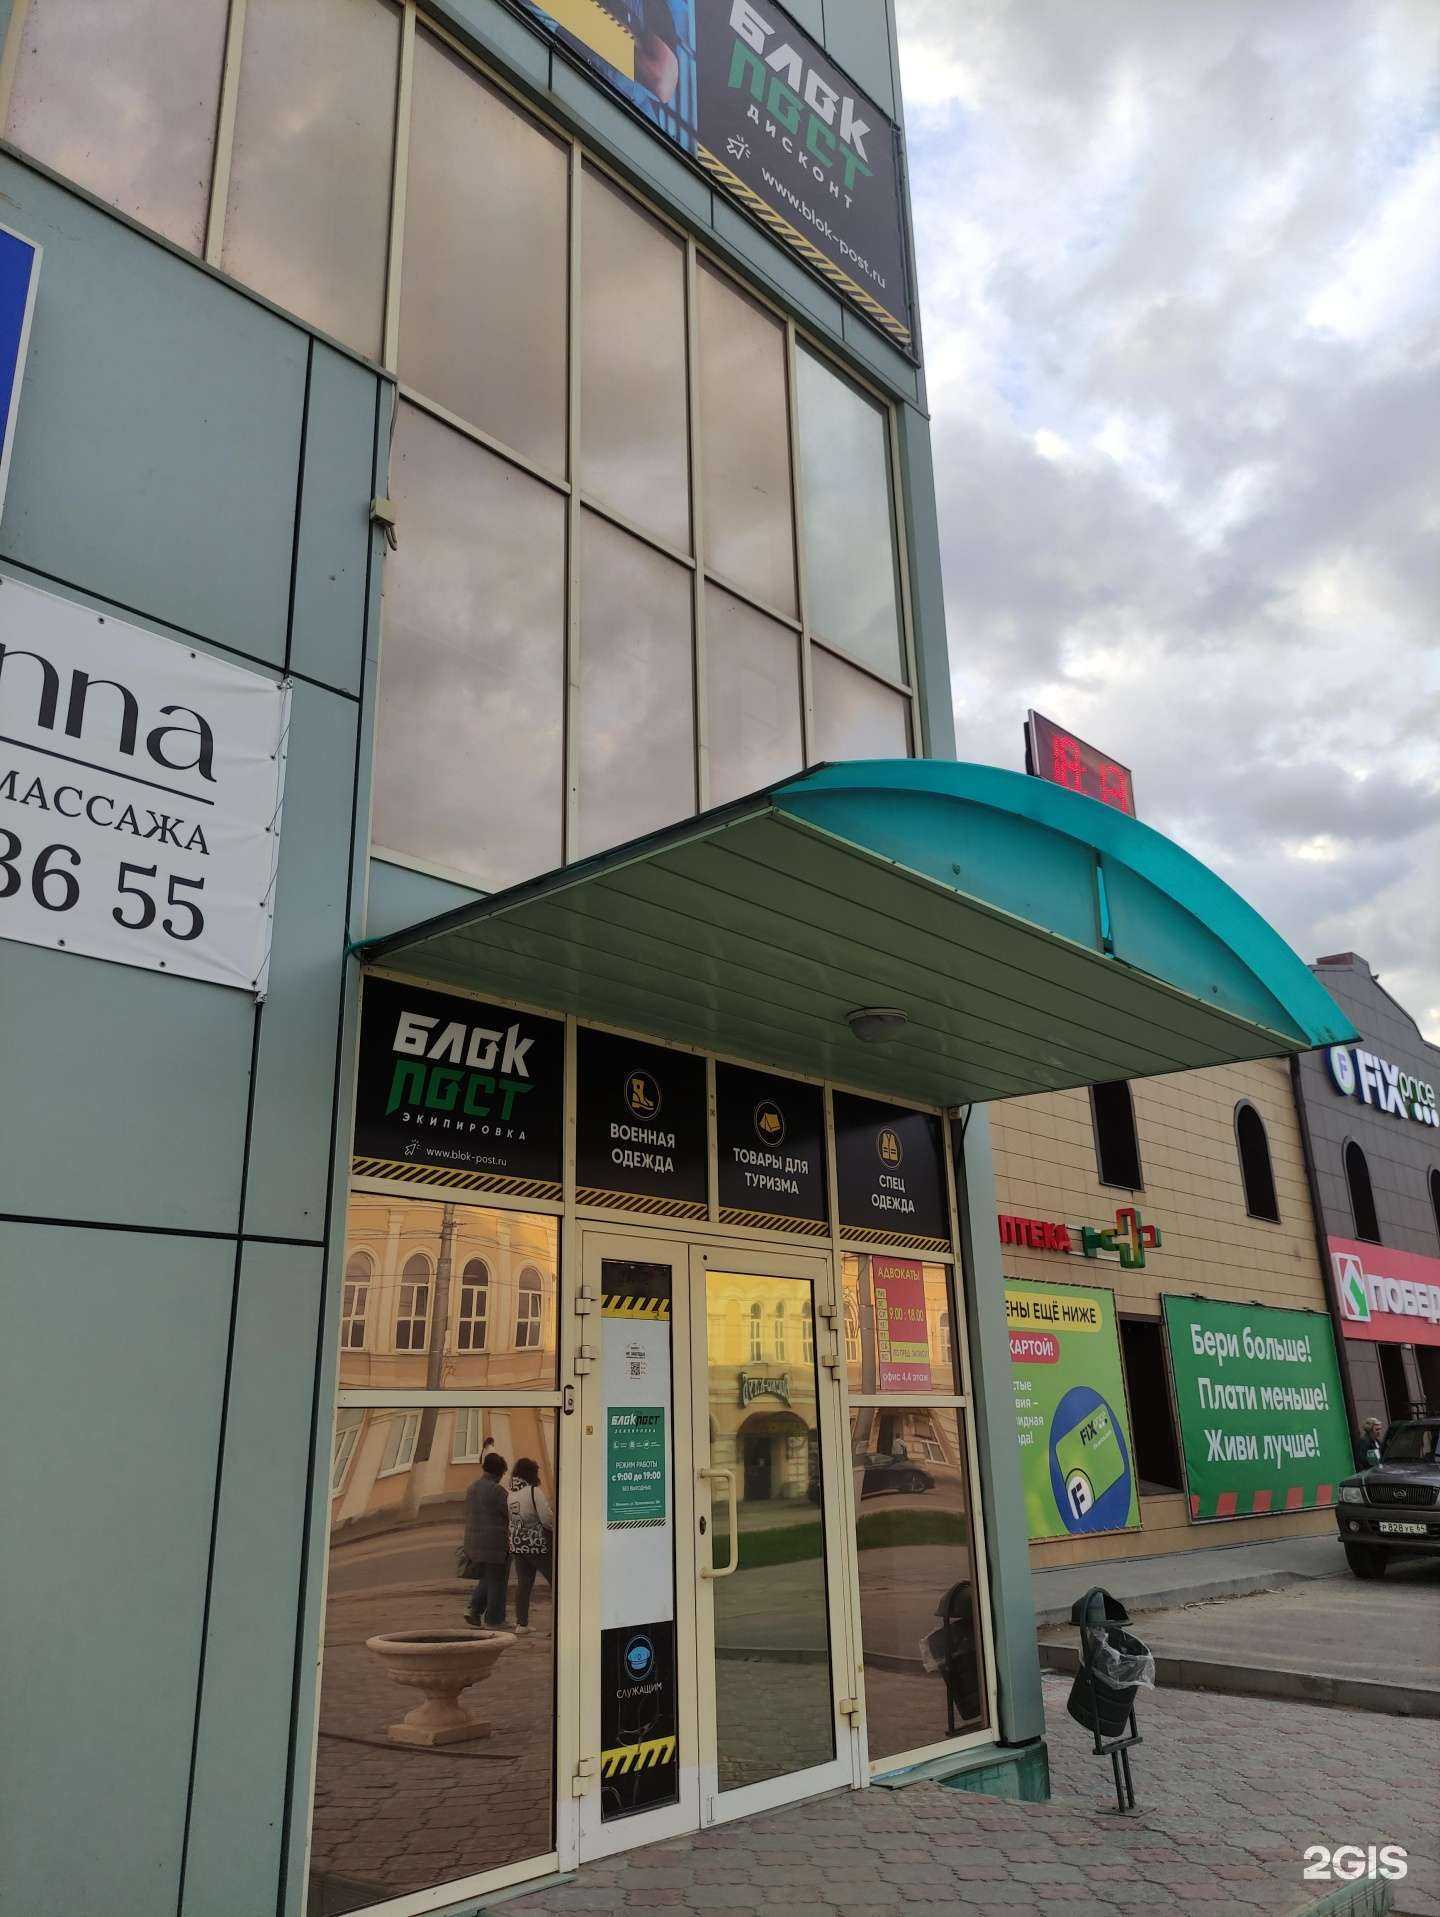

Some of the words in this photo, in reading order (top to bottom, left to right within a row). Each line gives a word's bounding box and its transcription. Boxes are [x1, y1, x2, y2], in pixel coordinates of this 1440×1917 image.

[729, 0, 871, 162] БЛОК
[728, 39, 874, 190] ПОСТ
[747, 104, 852, 208] ДИСКОНТ
[762, 168, 887, 289] www.blok-post.ru
[112, 861, 205, 941] 55
[392, 1010, 536, 1078] БЛОК
[385, 1059, 536, 1120] ПОСТ
[402, 1112, 526, 1141] ЭКИПИРОВКА
[610, 1122, 675, 1149] ВОЕННАЯ
[426, 1147, 507, 1167] www.blok-post.ru
[612, 1148, 674, 1173] ОДЕЖДА
[733, 1147, 783, 1170] ТОВАРЫ
[785, 1157, 809, 1175] ДЛЯ
[745, 1172, 799, 1194] ТУРИЗМА
[879, 1174, 906, 1193] СПЕЦ
[871, 1193, 915, 1214] ОДЕЖДА
[878, 1267, 920, 1281] АДВОКАТЫ
[1033, 1301, 1060, 1323] ЕЩЁ
[1063, 1306, 1097, 1324] НИЖЕ
[1190, 1323, 1240, 1367] Бери
[1242, 1326, 1312, 1363] больше!
[1198, 1377, 1258, 1410] Плати
[1260, 1382, 1329, 1411] меньше!
[1204, 1429, 1259, 1462] Живи
[1263, 1428, 1321, 1469] лучше!
[617, 1472, 633, 1481] 9:00
[633, 1473, 643, 1482] до
[643, 1471, 661, 1480] 19:00
[616, 1682, 663, 1699] СЛУЖАЩИМ
